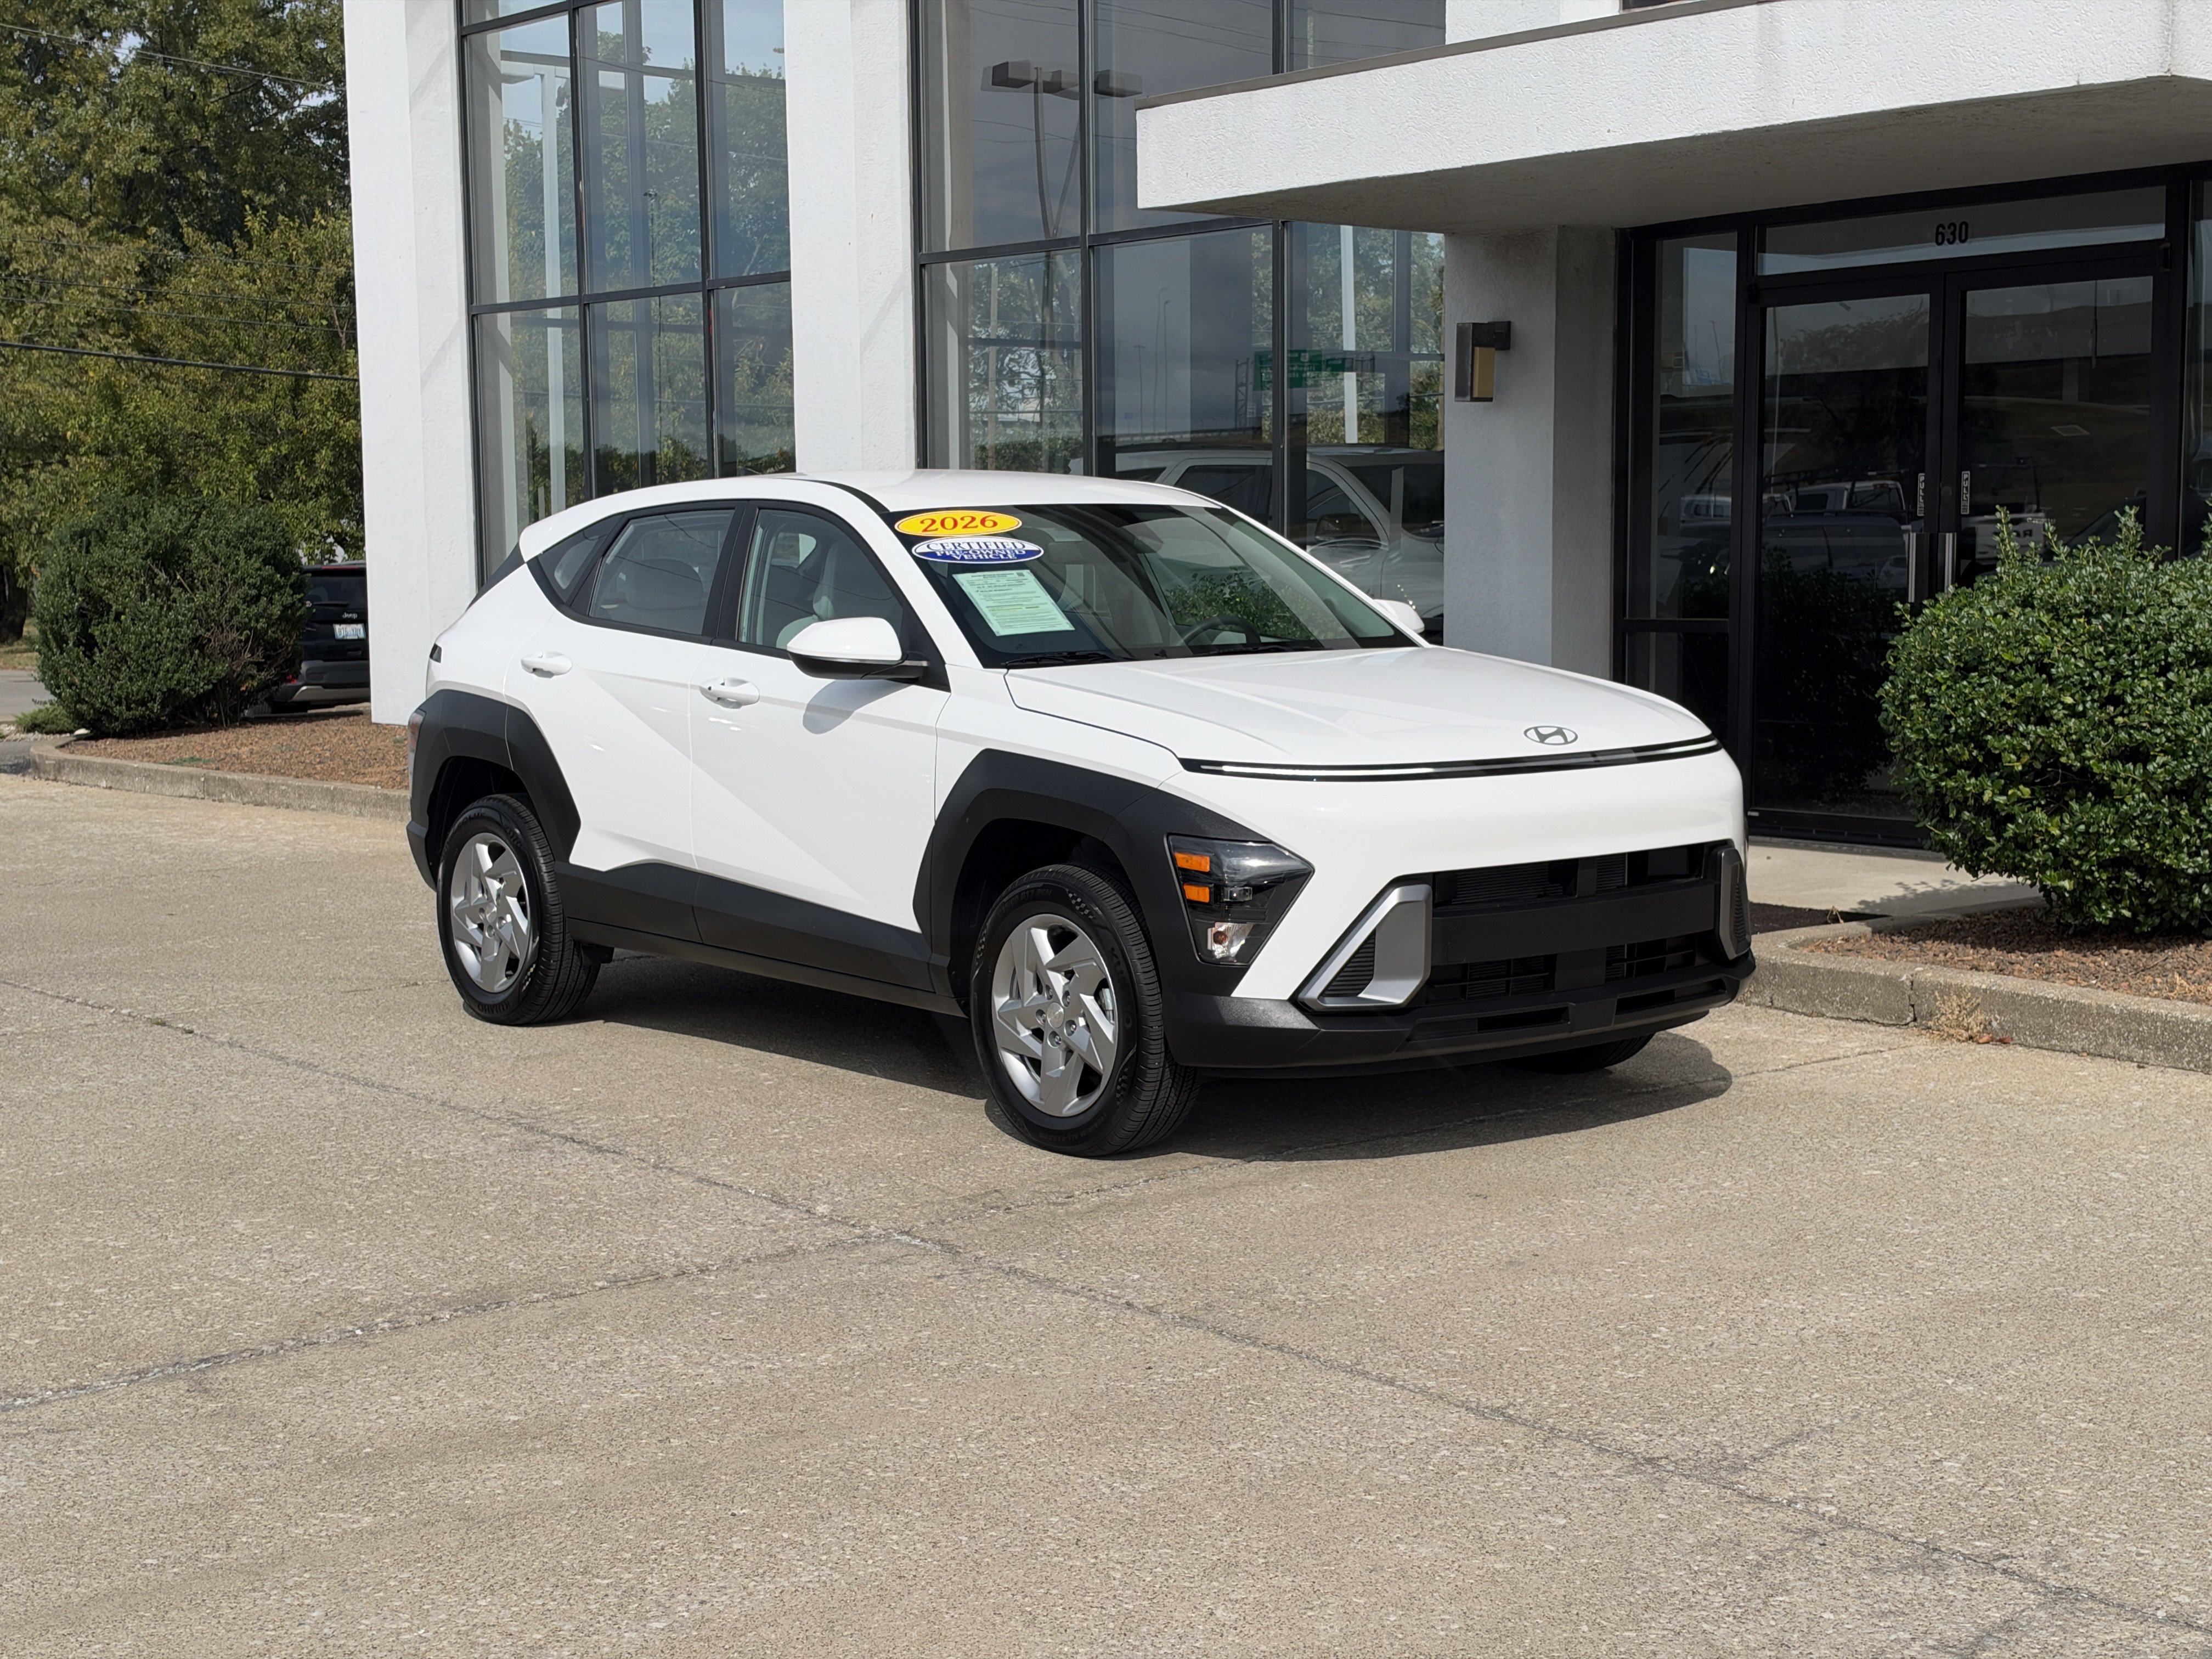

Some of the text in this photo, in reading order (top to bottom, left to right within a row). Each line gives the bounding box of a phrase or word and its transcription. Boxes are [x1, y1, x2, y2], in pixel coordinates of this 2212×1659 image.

[1934, 221, 1969, 246] 630
[919, 515, 998, 533] 2026
[926, 541, 1026, 551] CERTIFIED
